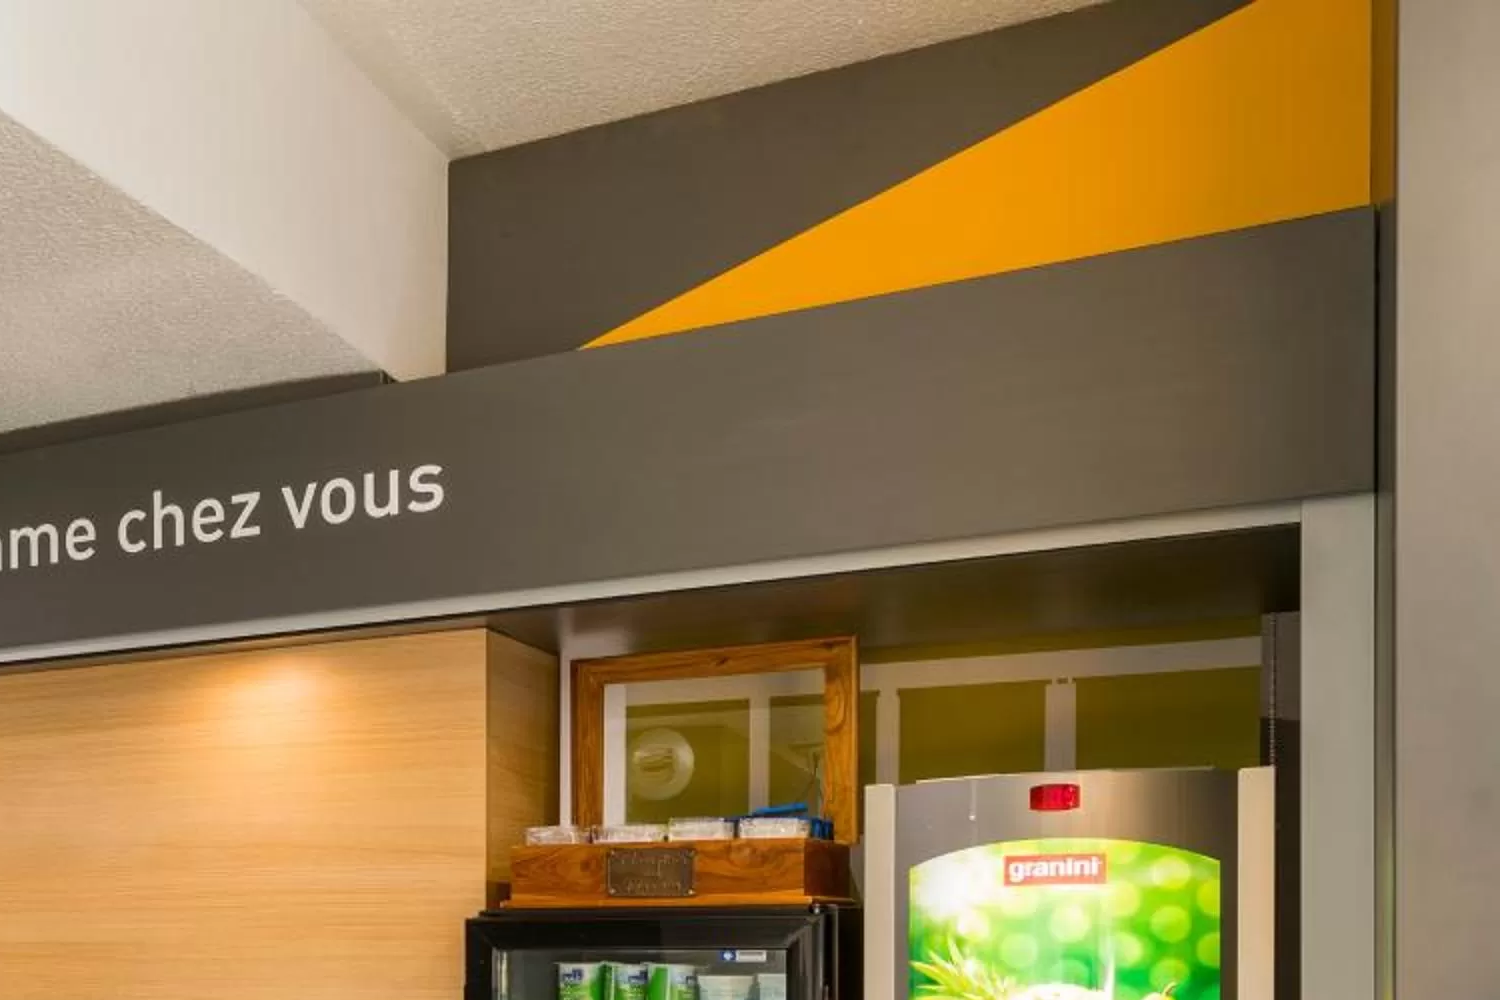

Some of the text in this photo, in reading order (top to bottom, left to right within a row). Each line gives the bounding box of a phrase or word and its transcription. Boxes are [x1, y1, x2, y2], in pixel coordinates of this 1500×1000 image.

[117, 490, 261, 553] chez
[281, 464, 445, 529] vous
[1008, 856, 1099, 883] granini
